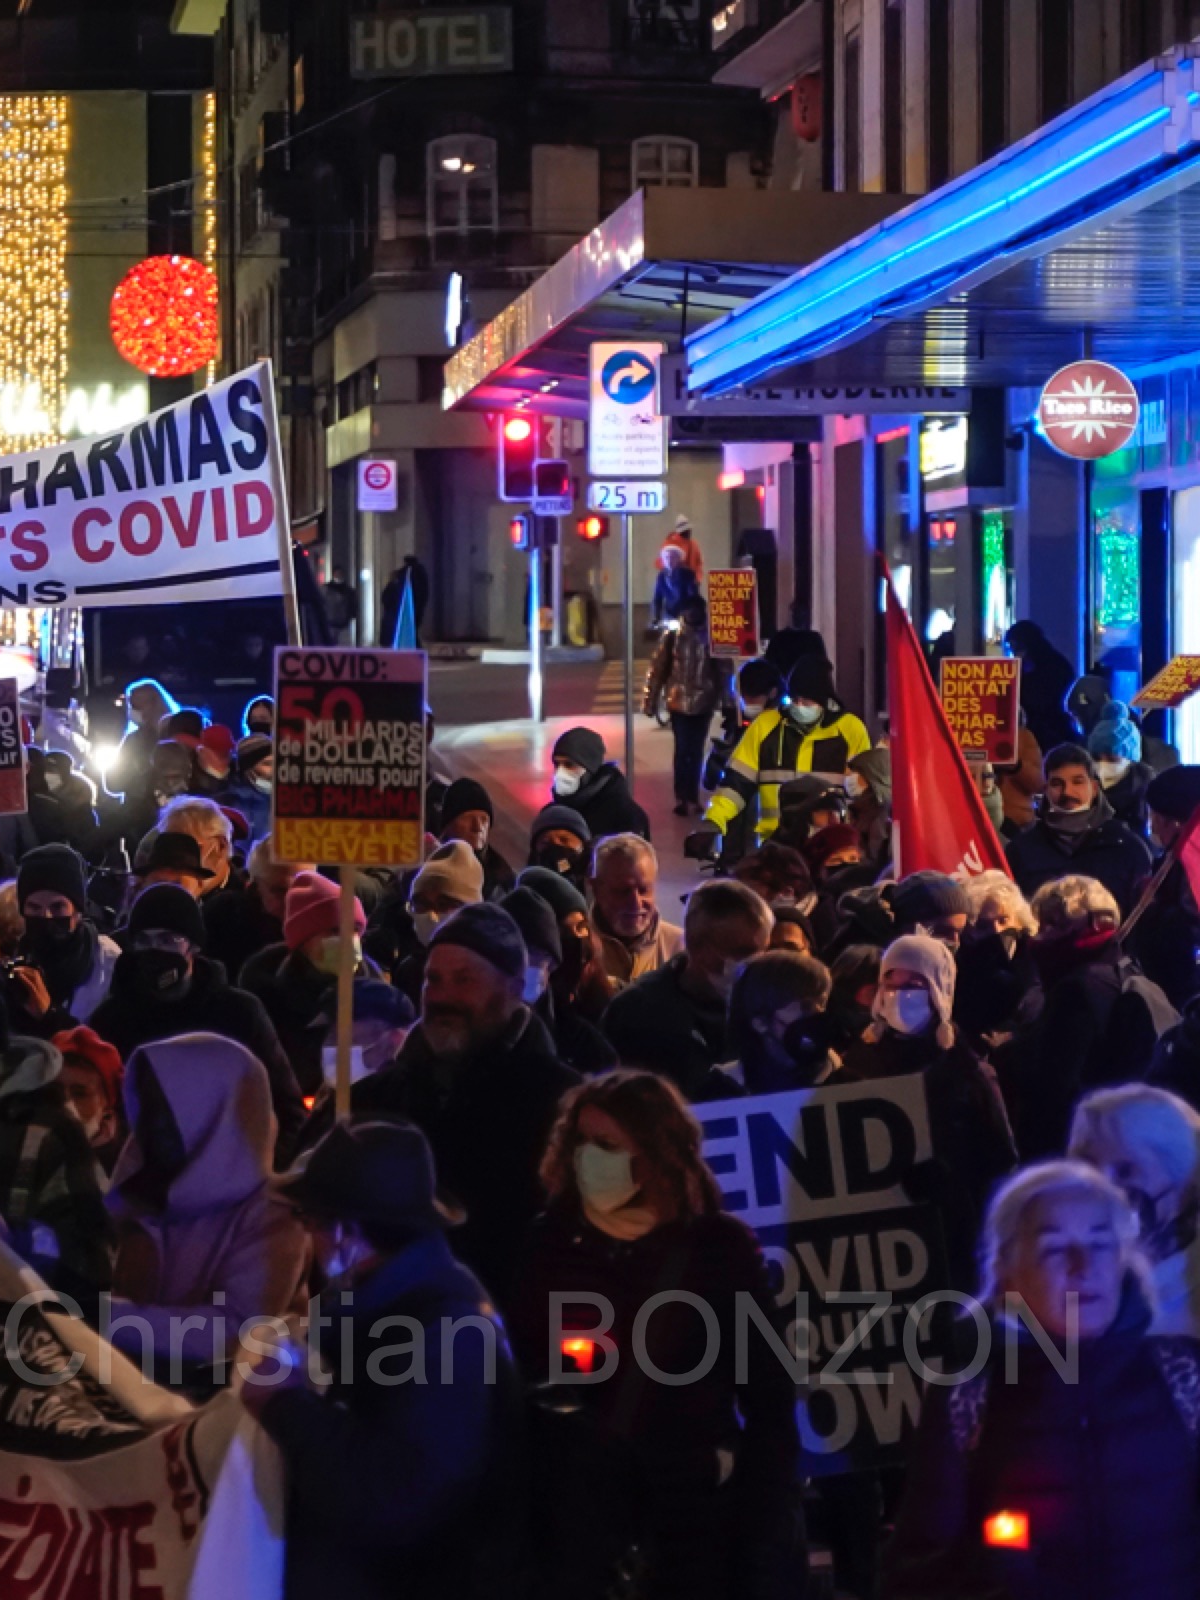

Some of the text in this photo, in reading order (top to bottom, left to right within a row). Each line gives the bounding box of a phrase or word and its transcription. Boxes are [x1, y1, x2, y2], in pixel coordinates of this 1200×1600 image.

[354, 13, 505, 70] HOTEL
[1043, 398, 1133, 415] Taco Rico
[597, 485, 659, 509] 25 m
[71, 479, 275, 564] COVID
[710, 601, 735, 615] DES
[280, 652, 389, 681] COVID:
[943, 663, 1017, 679] NON AU
[943, 680, 1011, 696] DIKTAT
[280, 686, 365, 745] 50
[943, 697, 981, 713] DES
[304, 720, 423, 745] MILLIARDS
[278, 735, 423, 767] de DOLLARS
[278, 761, 301, 784] de
[379, 766, 421, 793] pour
[278, 786, 420, 817] BIG PHARMA
[279, 837, 418, 863] BREVETS
[700, 1096, 917, 1212] END
[765, 1228, 930, 1308] OVID
[785, 1299, 937, 1362] QUITY
[794, 1355, 945, 1455] OW
